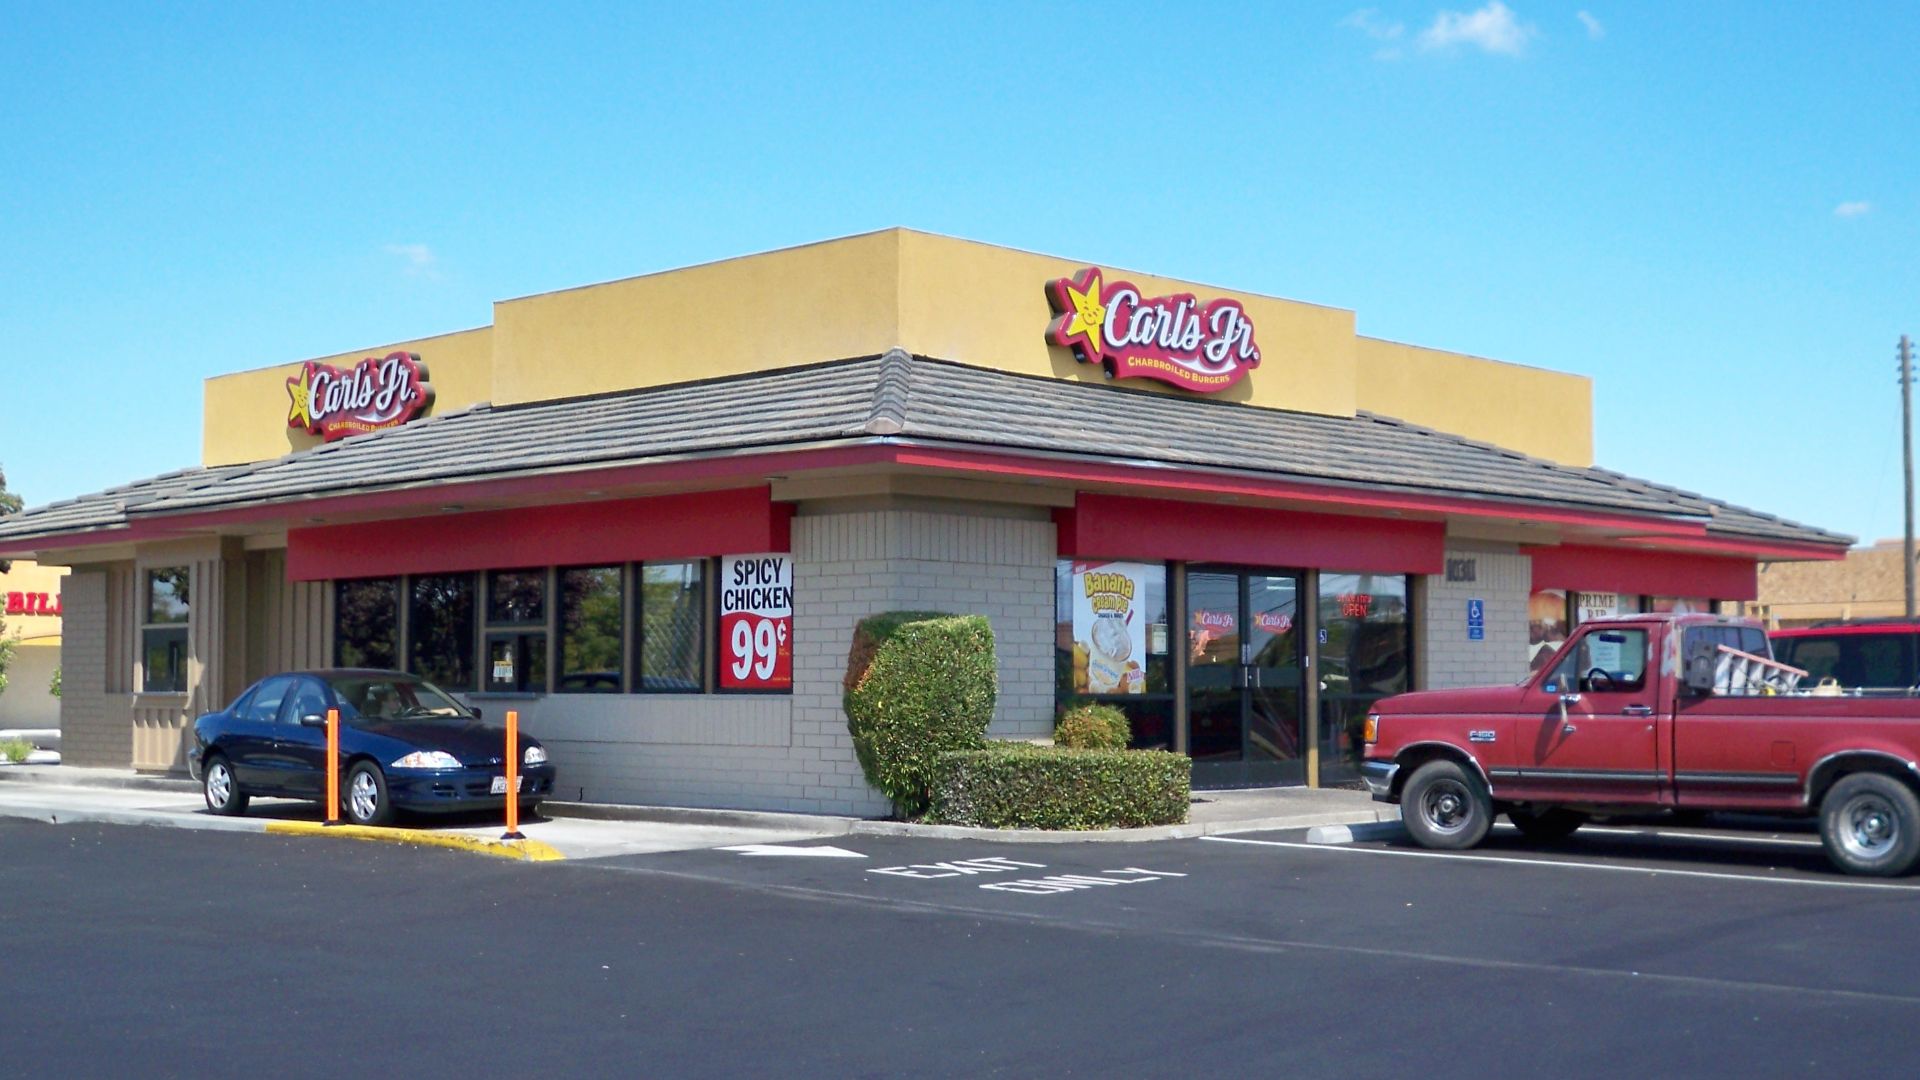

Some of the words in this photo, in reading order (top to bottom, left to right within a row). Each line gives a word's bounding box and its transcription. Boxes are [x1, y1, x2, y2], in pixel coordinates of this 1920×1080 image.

[1103, 289, 1205, 350] Carl's
[1204, 306, 1260, 362] Jr.
[1127, 355, 1191, 380] CHARBROILED
[1191, 373, 1230, 384] BURGERS
[308, 362, 375, 420] Carl's
[375, 358, 416, 410] Jr.
[733, 557, 783, 586] SPICY
[723, 586, 793, 611] CHICKEN
[1084, 572, 1135, 600] Banana
[1343, 603, 1368, 616] OPEN
[1580, 594, 1617, 608] PRIME
[866, 856, 1048, 879] EXIT
[978, 867, 1188, 895] ONLY
